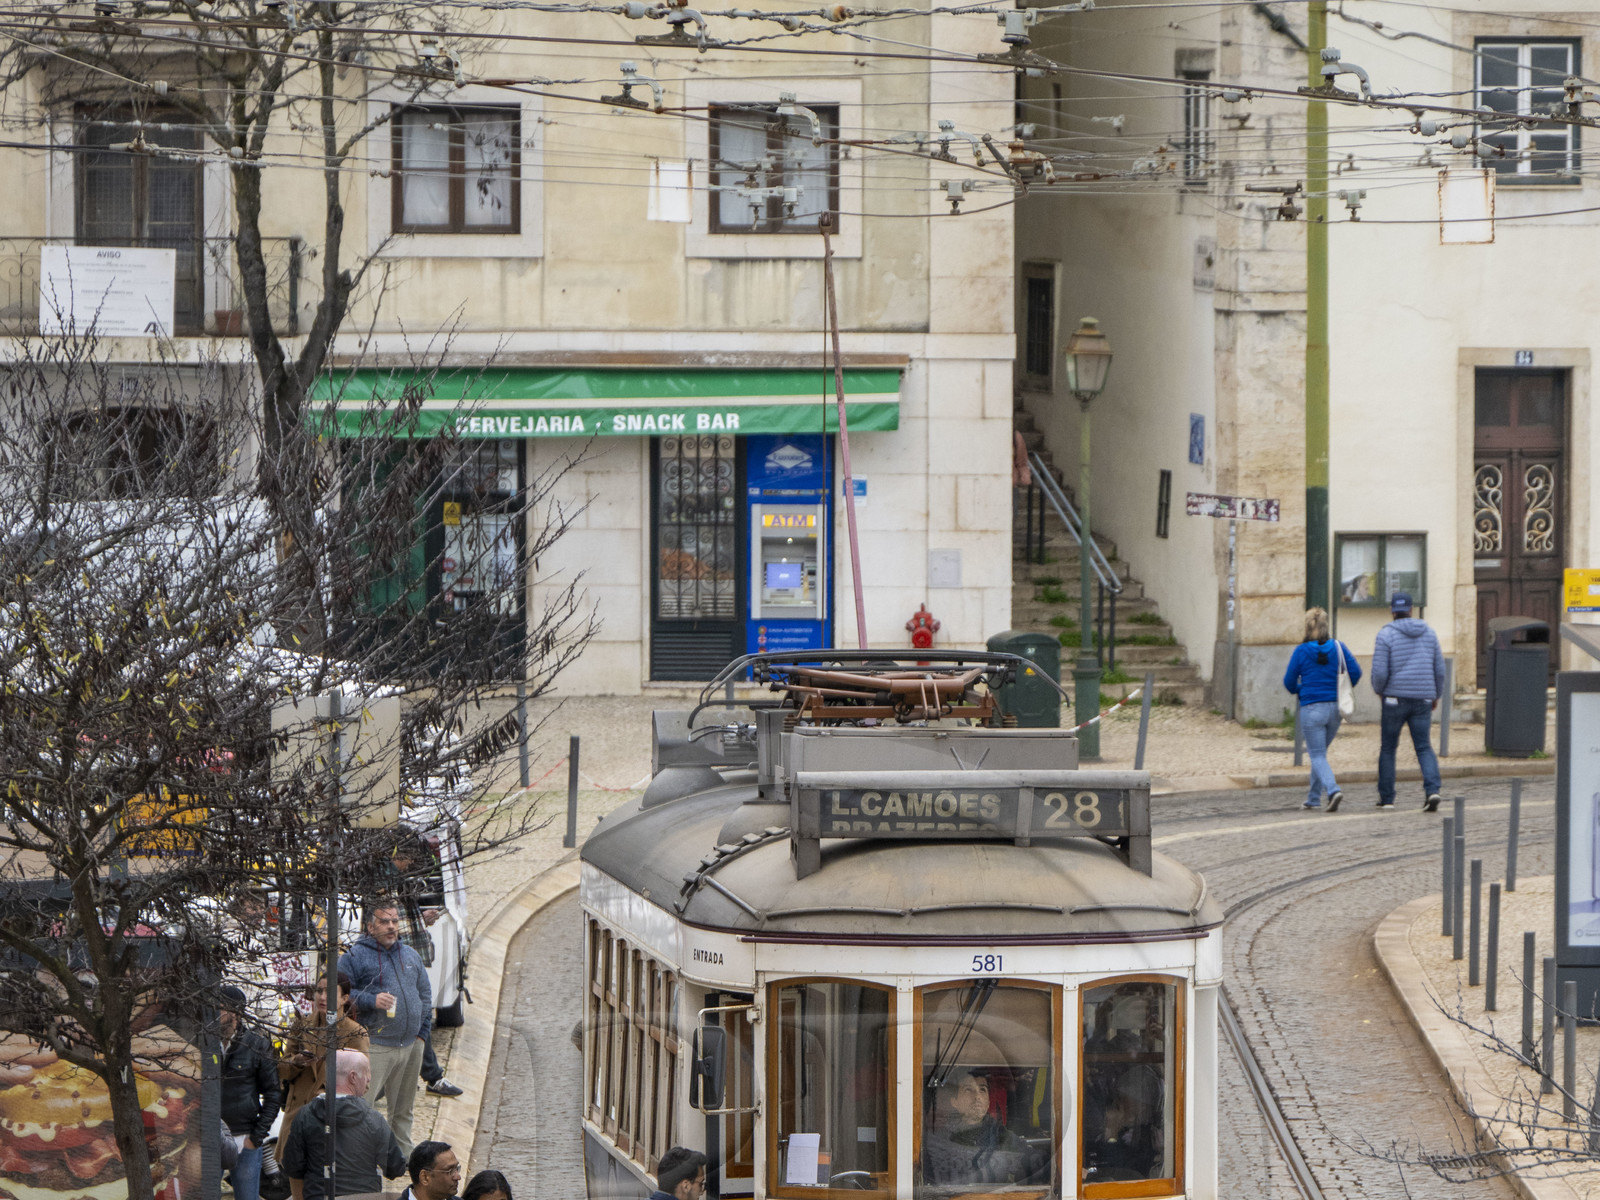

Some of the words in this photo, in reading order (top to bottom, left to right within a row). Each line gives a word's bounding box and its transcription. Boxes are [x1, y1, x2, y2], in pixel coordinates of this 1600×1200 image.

[97, 250, 121, 258] AVISO
[456, 416, 584, 434] CERVEJARIA
[613, 414, 685, 430] SNACK
[696, 413, 740, 429] BAR
[772, 516, 807, 526] ATM
[1044, 792, 1102, 828] 28
[693, 948, 724, 966] ENTRADA
[972, 954, 1004, 972] 581
